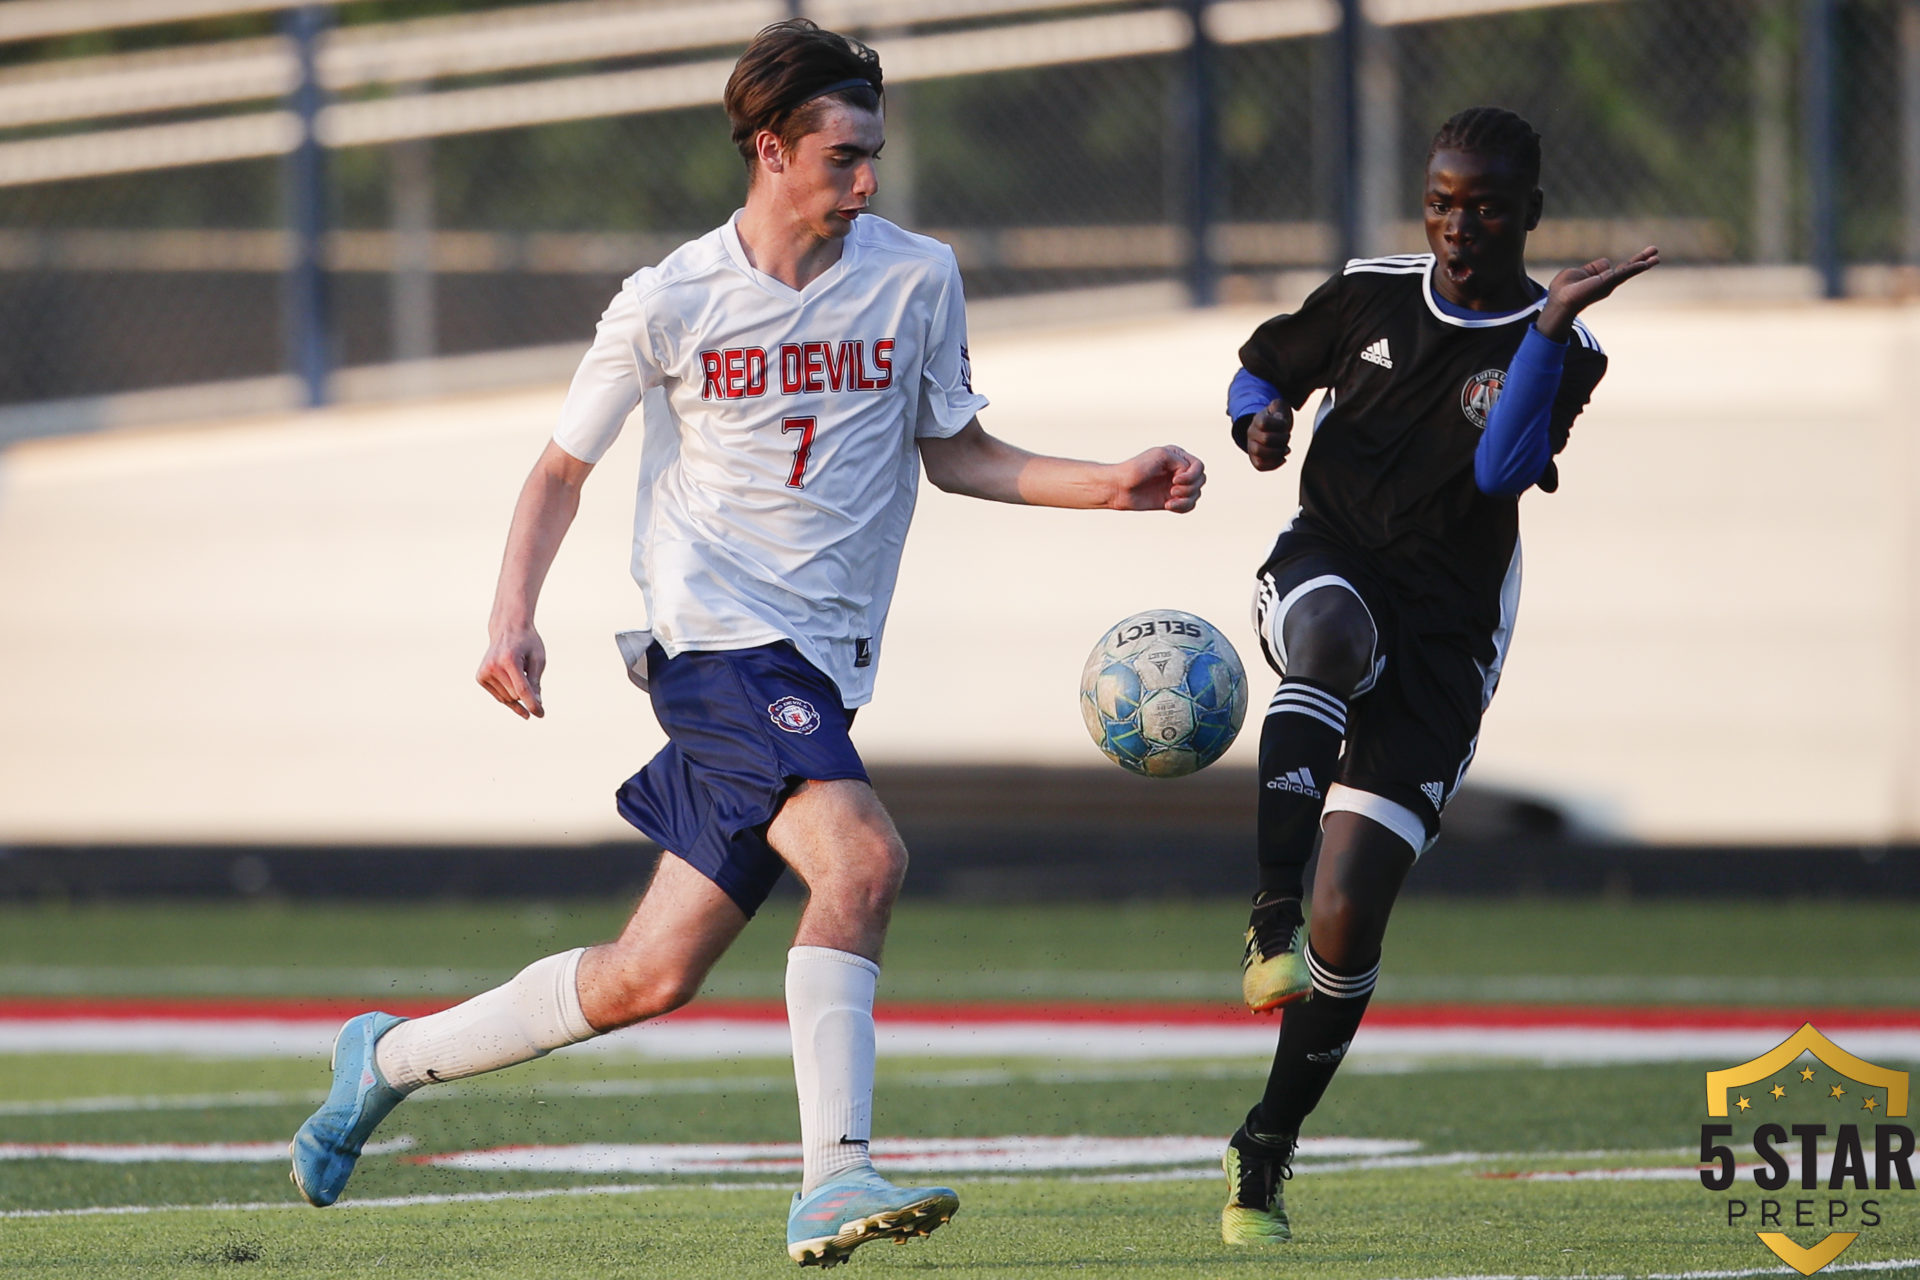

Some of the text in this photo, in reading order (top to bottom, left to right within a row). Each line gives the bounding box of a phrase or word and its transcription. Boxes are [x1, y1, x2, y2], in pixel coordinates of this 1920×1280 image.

[699, 338, 895, 401] RED DEVILS
[1360, 350, 1393, 369] adidas
[781, 416, 817, 489] 7
[1116, 620, 1201, 648] SELECT
[1266, 779, 1321, 800] adidas
